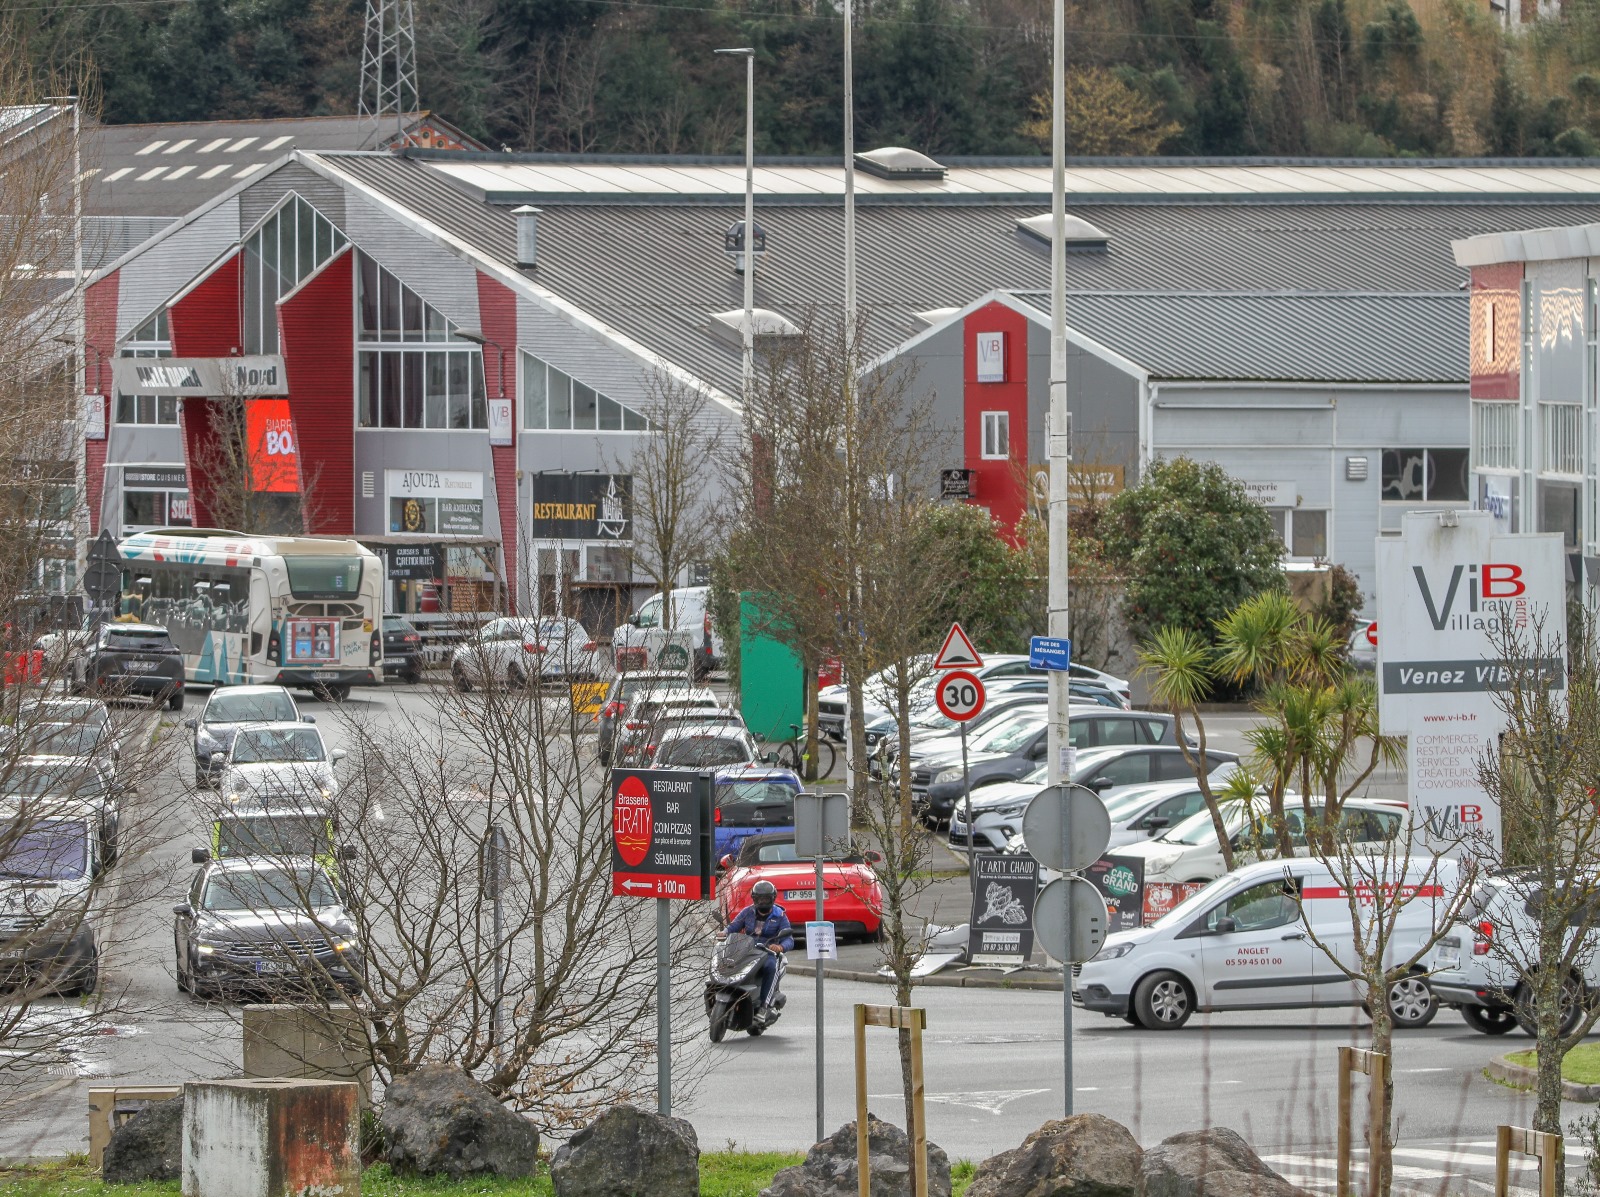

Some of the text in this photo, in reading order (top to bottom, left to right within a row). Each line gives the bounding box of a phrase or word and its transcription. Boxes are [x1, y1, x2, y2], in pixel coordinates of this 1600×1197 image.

[237, 366, 277, 386] Nord
[157, 473, 185, 481] CUISINES
[402, 472, 440, 493] AJOUPA
[171, 499, 193, 519] SOL
[534, 502, 597, 520] RESTAURANT
[397, 548, 420, 556] CUISSES
[1411, 563, 1526, 630] ViB
[1034, 647, 1066, 655] MÉSANGES
[1399, 668, 1465, 685] Venez
[945, 685, 977, 707] 30
[1423, 713, 1478, 722] www.v-i-b.fr
[1416, 734, 1479, 745] COMMERCES
[1416, 757, 1460, 767] SERVICES
[653, 780, 693, 793] RESTAURANT
[617, 793, 649, 806] Brasserie
[666, 801, 680, 814] BAR
[615, 806, 651, 833] IRATY
[654, 823, 692, 835] COIN PIZZAS
[654, 851, 692, 866] SÉMINAIRES
[980, 860, 1035, 874] L'ARTY CHAUD
[1111, 867, 1135, 882] CAFÉ
[657, 879, 686, 894] à 100 m
[1102, 874, 1139, 893] GRAND
[1122, 911, 1135, 919] bar
[1237, 947, 1270, 955] ANGLET
